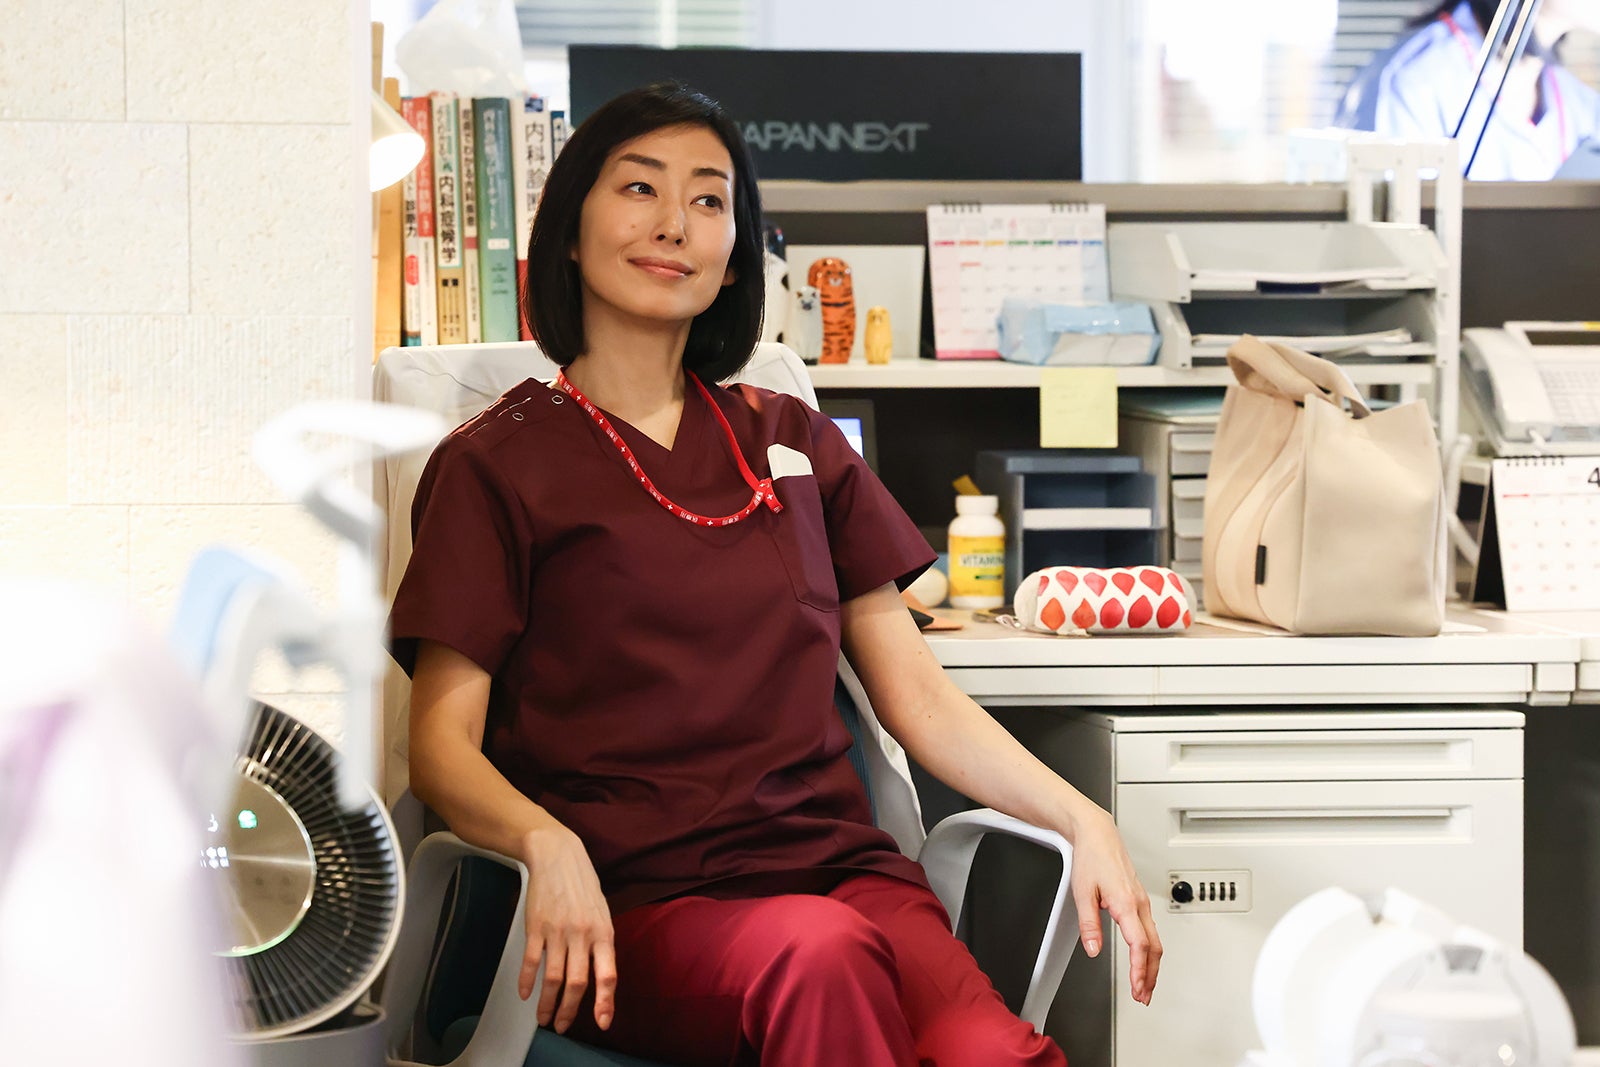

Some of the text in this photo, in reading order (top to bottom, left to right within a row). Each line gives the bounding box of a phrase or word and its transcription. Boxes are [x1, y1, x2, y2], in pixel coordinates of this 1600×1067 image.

[438, 175, 457, 263] 内科症候学
